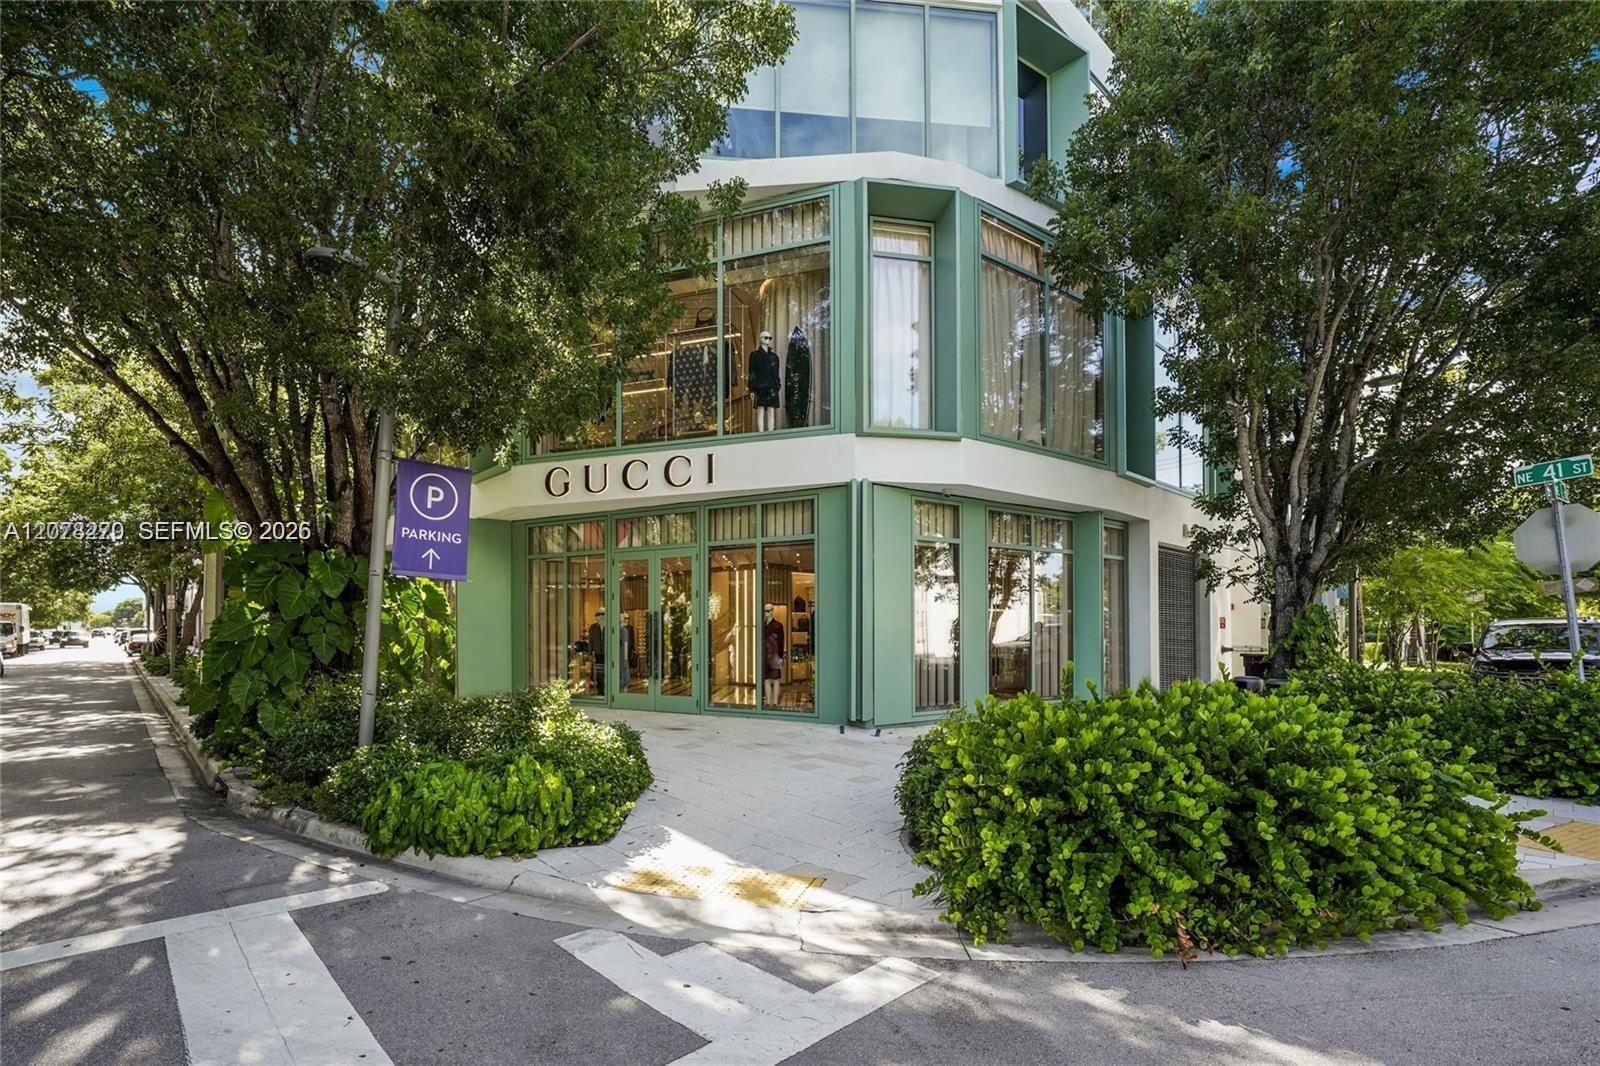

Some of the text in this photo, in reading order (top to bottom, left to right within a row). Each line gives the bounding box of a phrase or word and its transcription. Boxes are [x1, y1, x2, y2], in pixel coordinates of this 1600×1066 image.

[544, 453, 714, 498] GUCCI
[1516, 461, 1588, 484] NE 41 ST
[426, 485, 445, 509] P
[401, 527, 462, 544] PARKING
